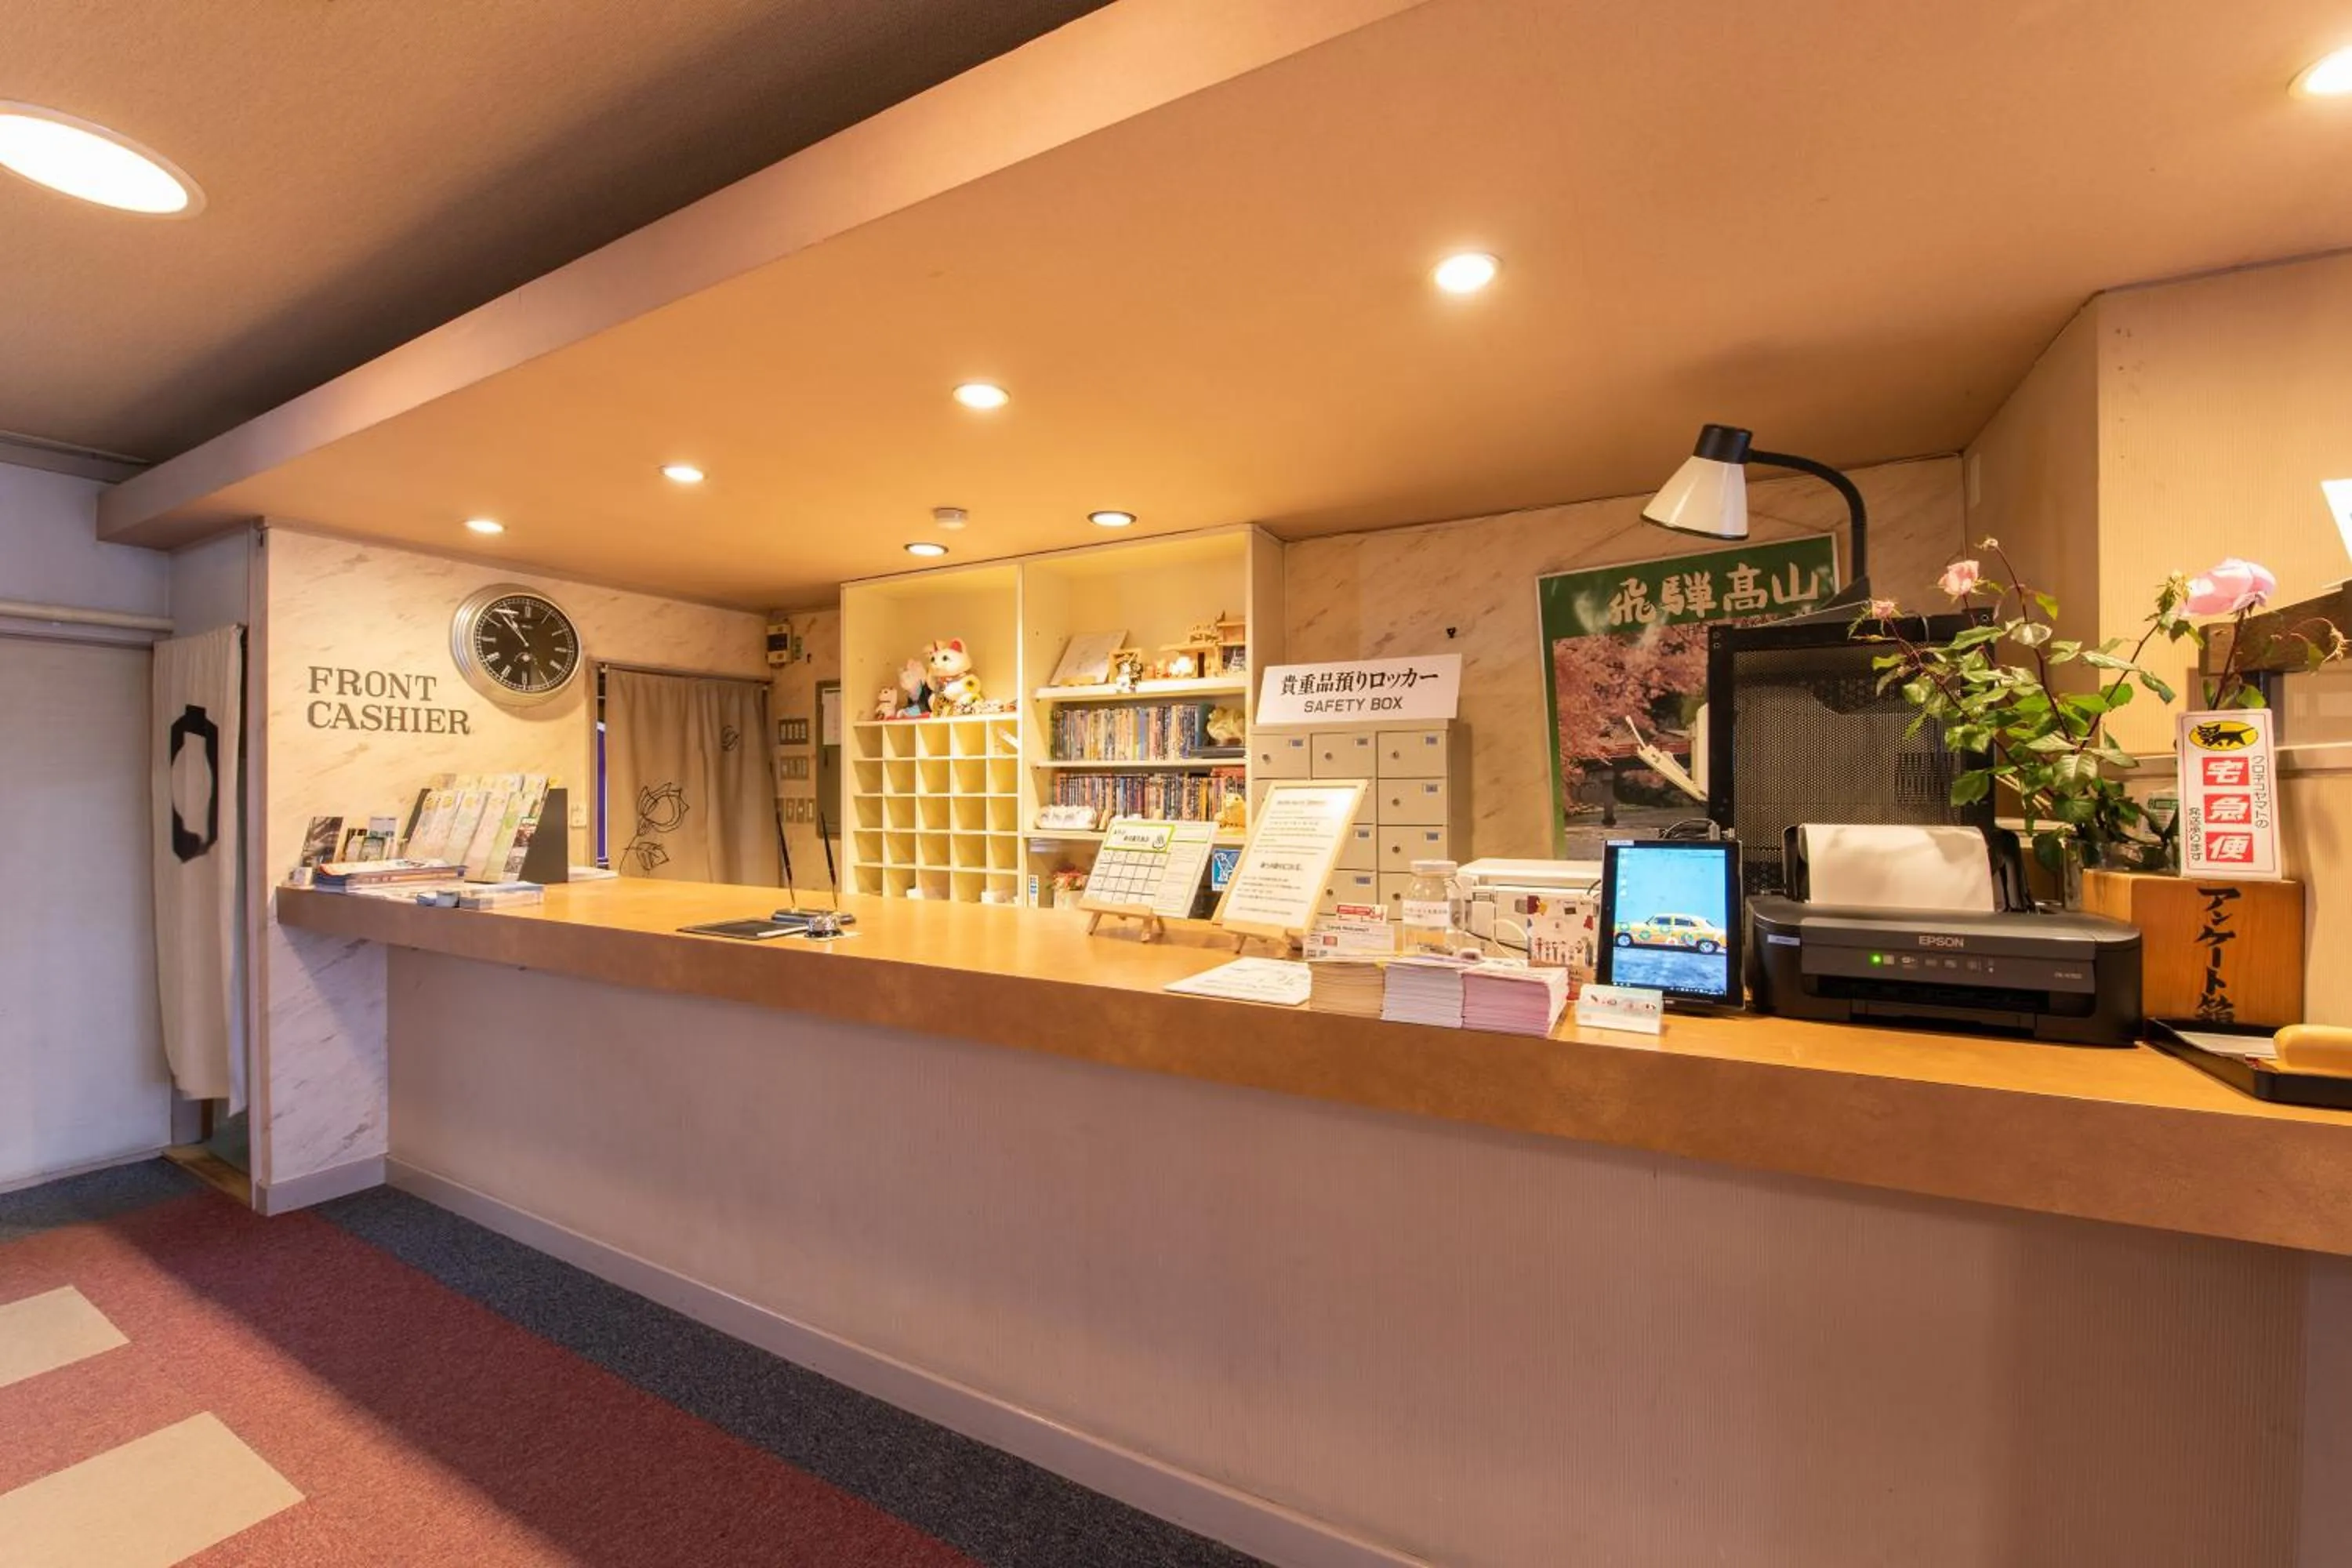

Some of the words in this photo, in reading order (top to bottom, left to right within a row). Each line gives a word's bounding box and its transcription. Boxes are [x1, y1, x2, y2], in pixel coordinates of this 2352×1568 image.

[307, 666, 437, 702] FRONT
[1280, 666, 1439, 696] 貴重品預りロッカー
[307, 700, 470, 735] CASHIER
[1304, 699, 1367, 713] SAFETY
[1370, 696, 1403, 711] BOX
[2251, 755, 2270, 829] クロネコヤマトの
[2205, 760, 2252, 861] 宅急便
[1918, 935, 1965, 949] EPSON
